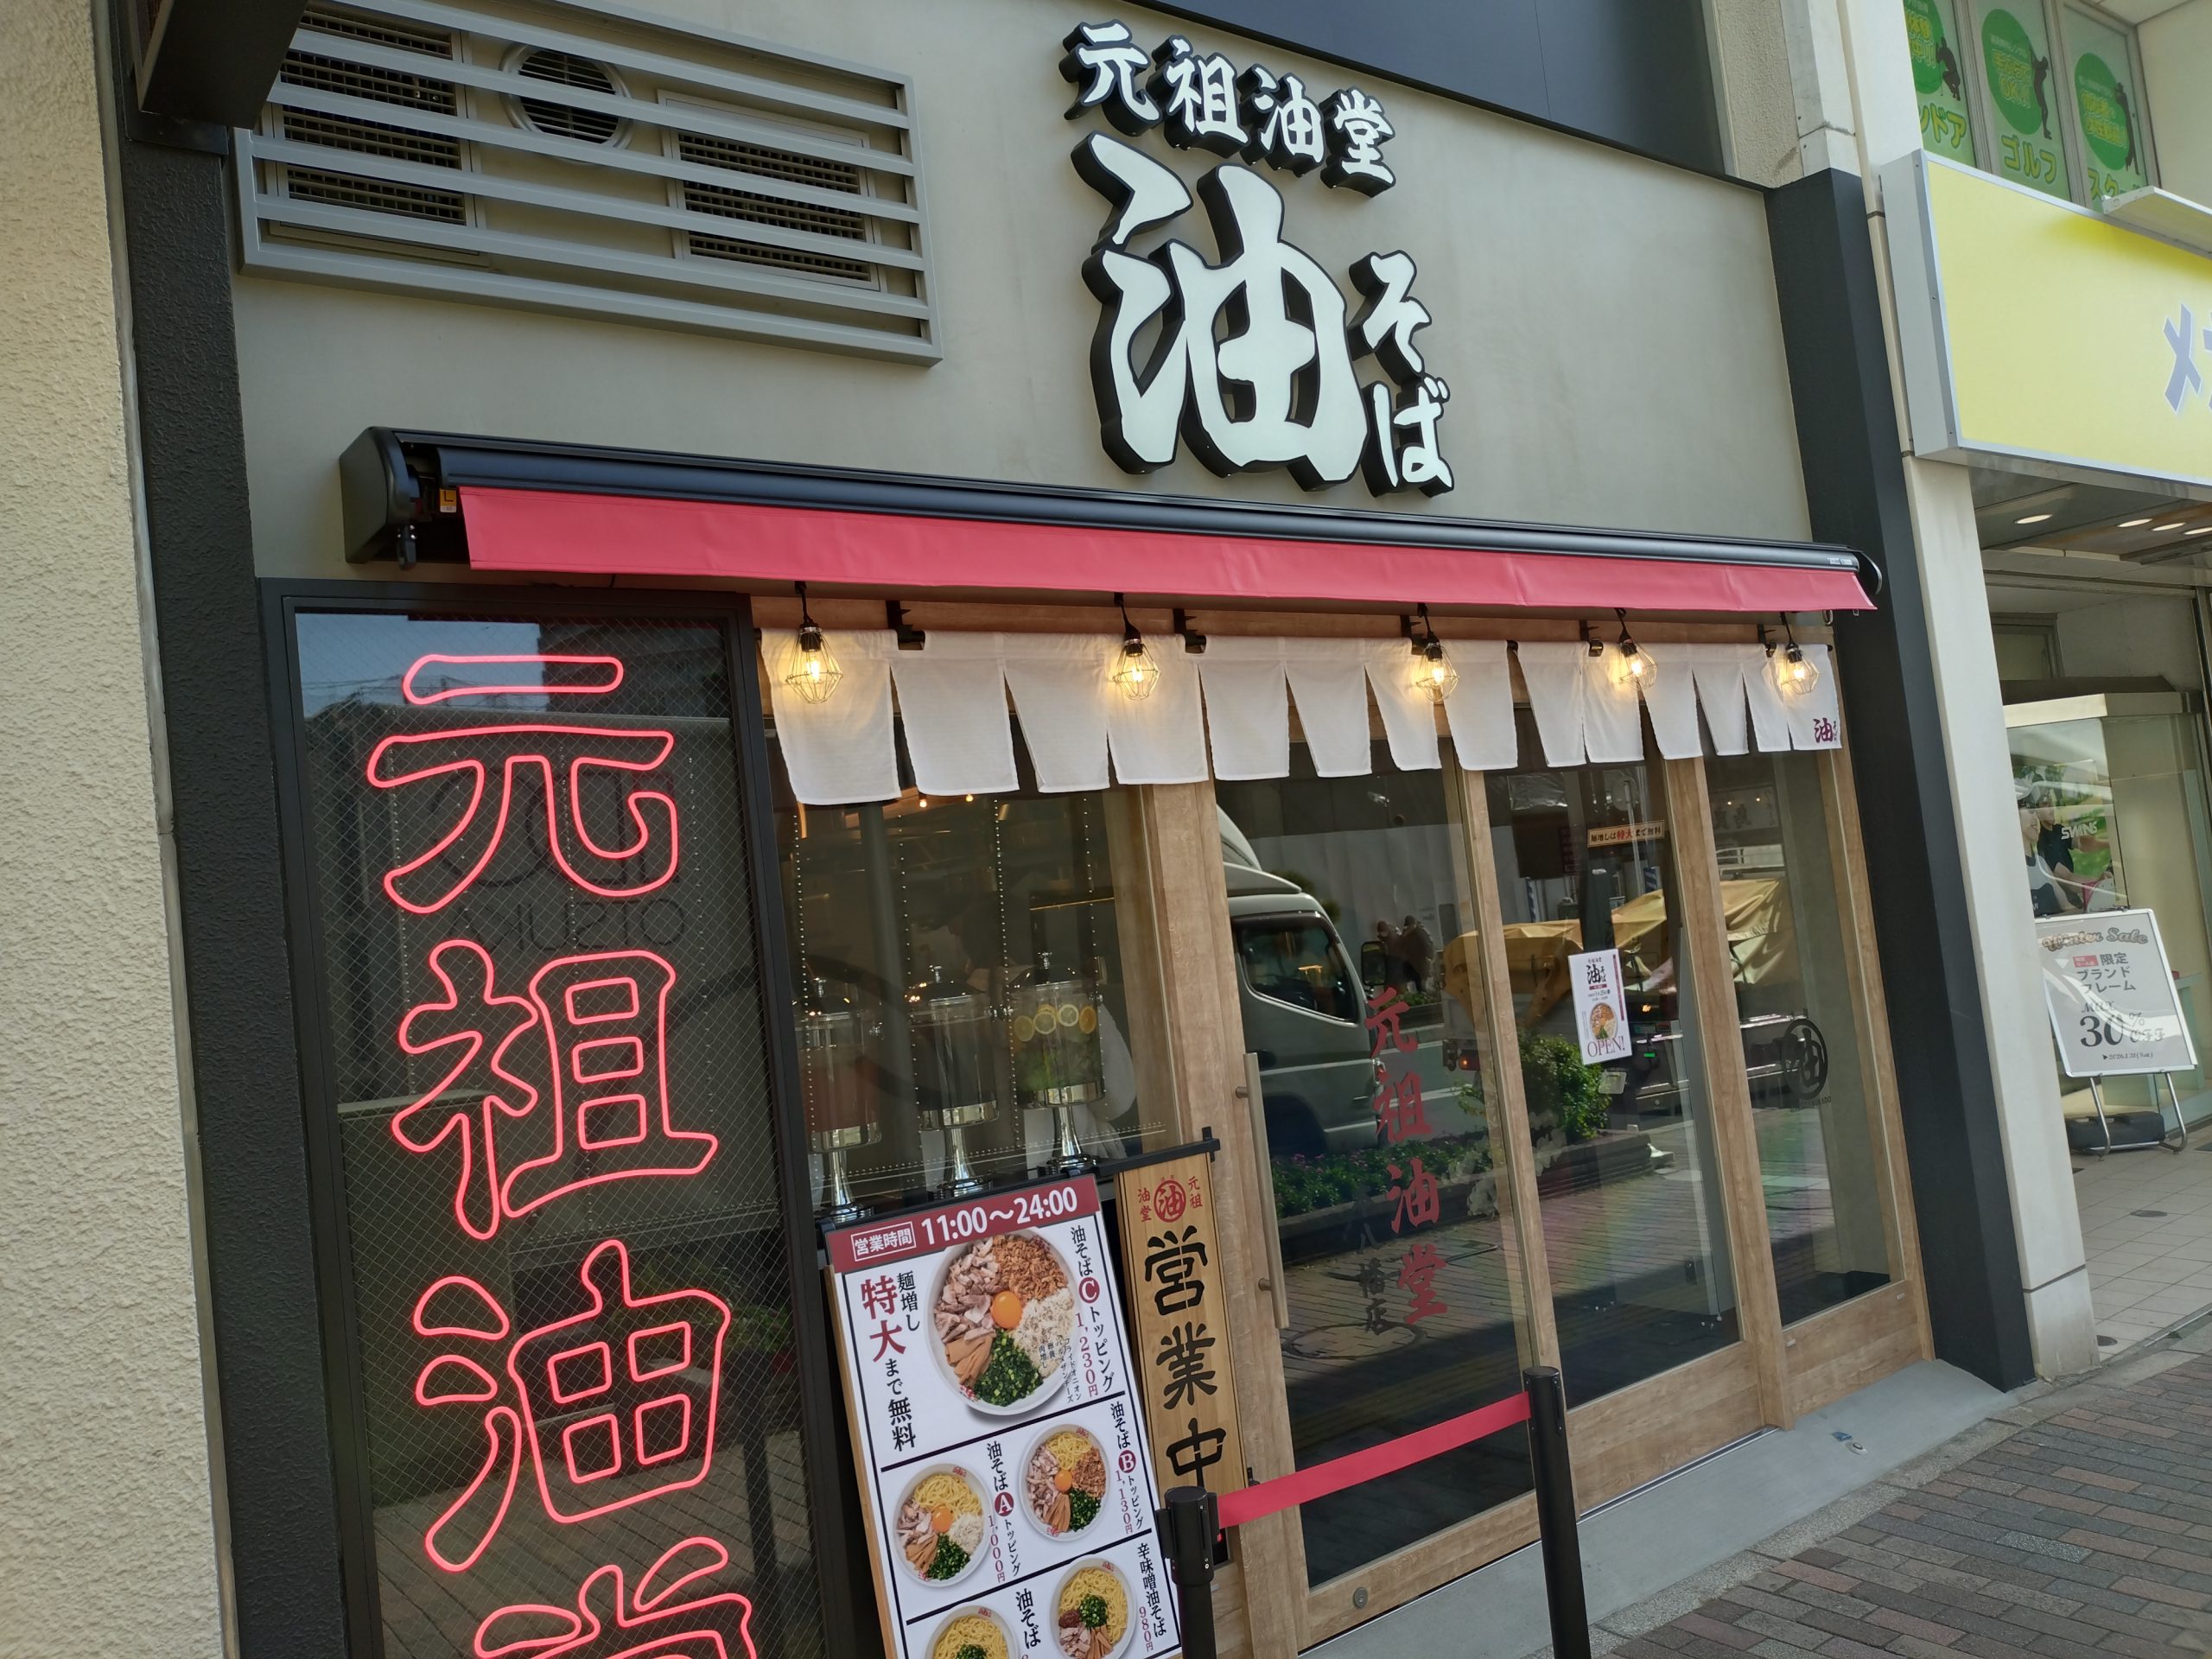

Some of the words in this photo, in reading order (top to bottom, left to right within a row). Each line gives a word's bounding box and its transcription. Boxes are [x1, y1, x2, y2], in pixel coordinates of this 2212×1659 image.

[1061, 21, 1395, 194] 元祖油堂
[2000, 134, 2056, 184] ゴルフ
[1073, 131, 1368, 489] 油
[1353, 250, 1453, 494] そば
[2164, 303, 2212, 416] メ
[1813, 717, 1833, 743] 油
[2042, 931, 2103, 951] Winter
[2107, 927, 2148, 944] Sale
[2101, 952, 2129, 965] 限定
[1586, 963, 1601, 984] 油
[2077, 966, 2131, 981] ブランド
[2081, 980, 2136, 994] フレーム
[1587, 1036, 1625, 1058] OPEN!
[1363, 986, 1449, 1325] 元祖油堂
[1137, 1187, 1153, 1223] 油堂
[1157, 1184, 1184, 1219] 油
[1188, 1176, 1204, 1209] 元祖
[854, 1227, 913, 1256] 営業時間
[897, 1270, 921, 1332] 麺増し
[1075, 1312, 1099, 1398] 1,230円
[1144, 1224, 1227, 1487] 営業中
[1116, 1470, 1134, 1534] 1,130円
[988, 1515, 1006, 1583] 1,000円
[1137, 1542, 1167, 1637] 辛味噌油そば
[1015, 1588, 1042, 1649] 油そば
[1139, 1605, 1154, 1652] 980円
